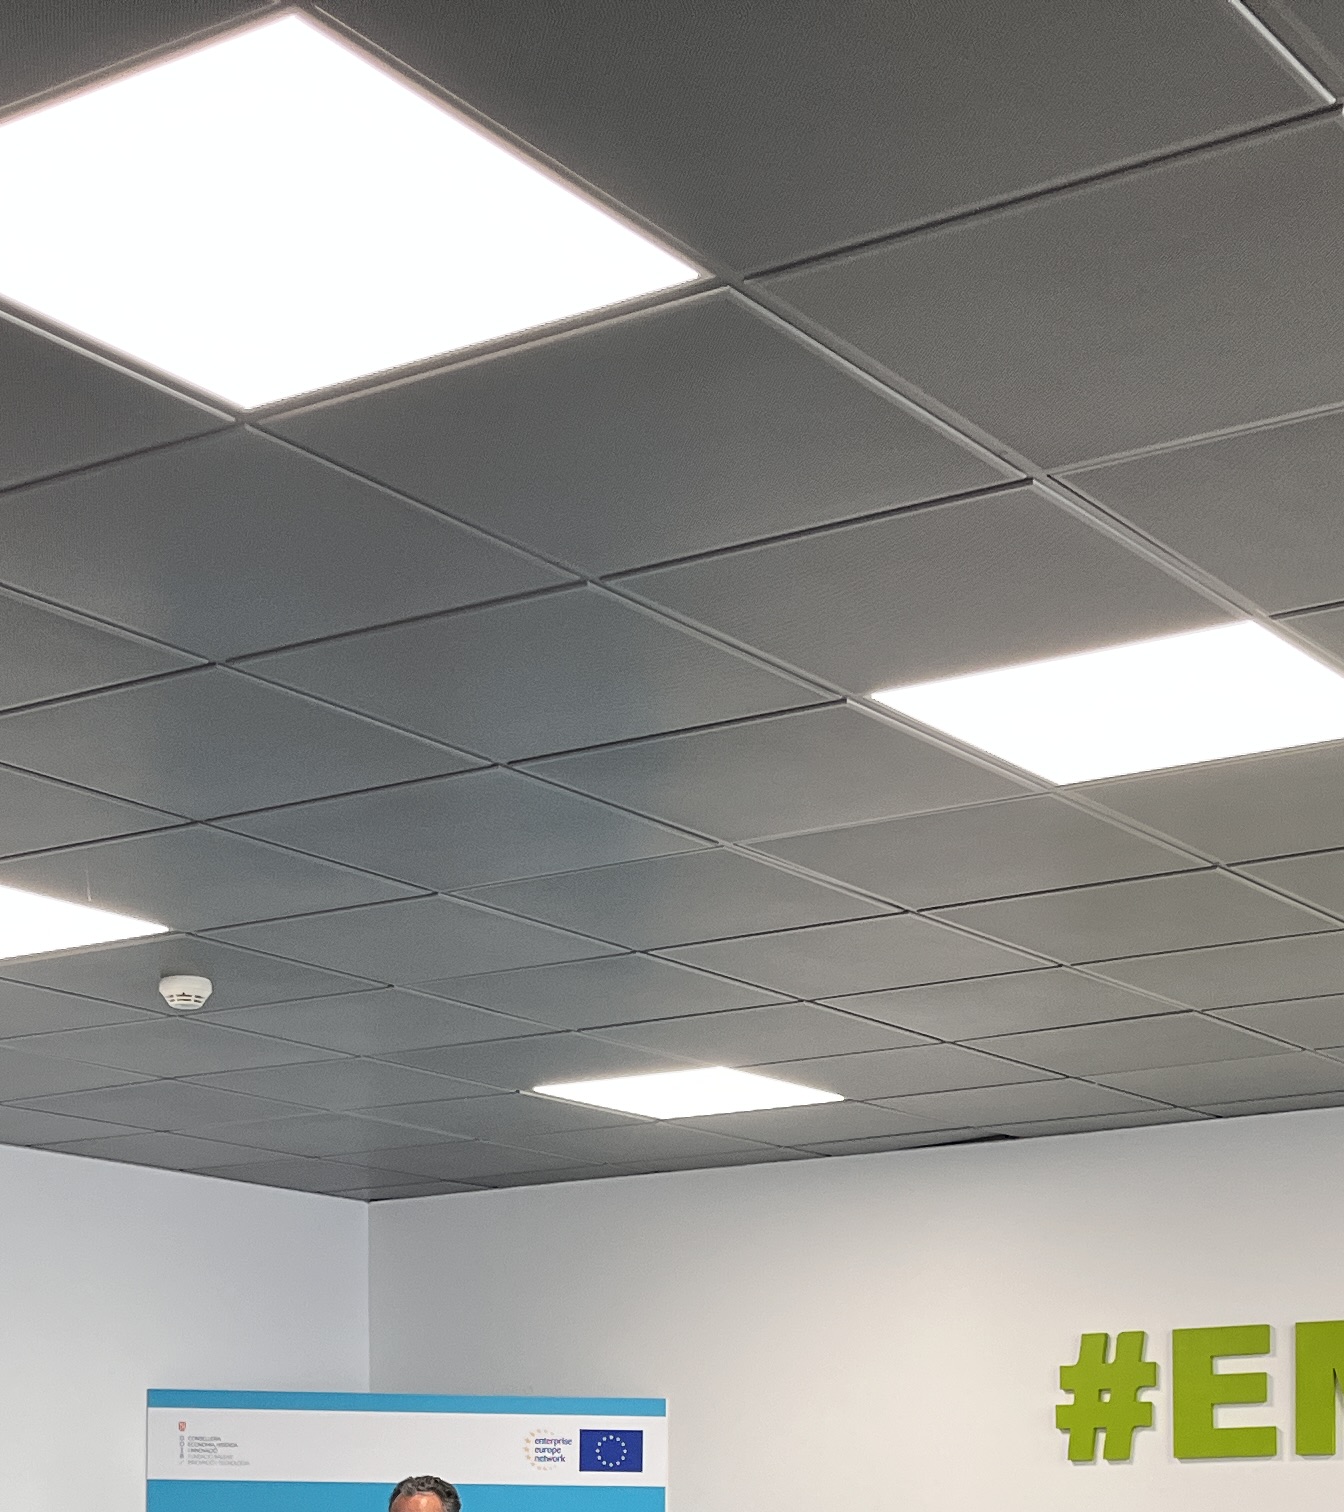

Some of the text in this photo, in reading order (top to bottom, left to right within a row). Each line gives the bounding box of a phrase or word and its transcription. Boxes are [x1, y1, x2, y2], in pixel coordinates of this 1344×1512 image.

[534, 1438, 573, 1446] enterprise
[534, 1447, 562, 1455] europe
[534, 1454, 566, 1462] network
